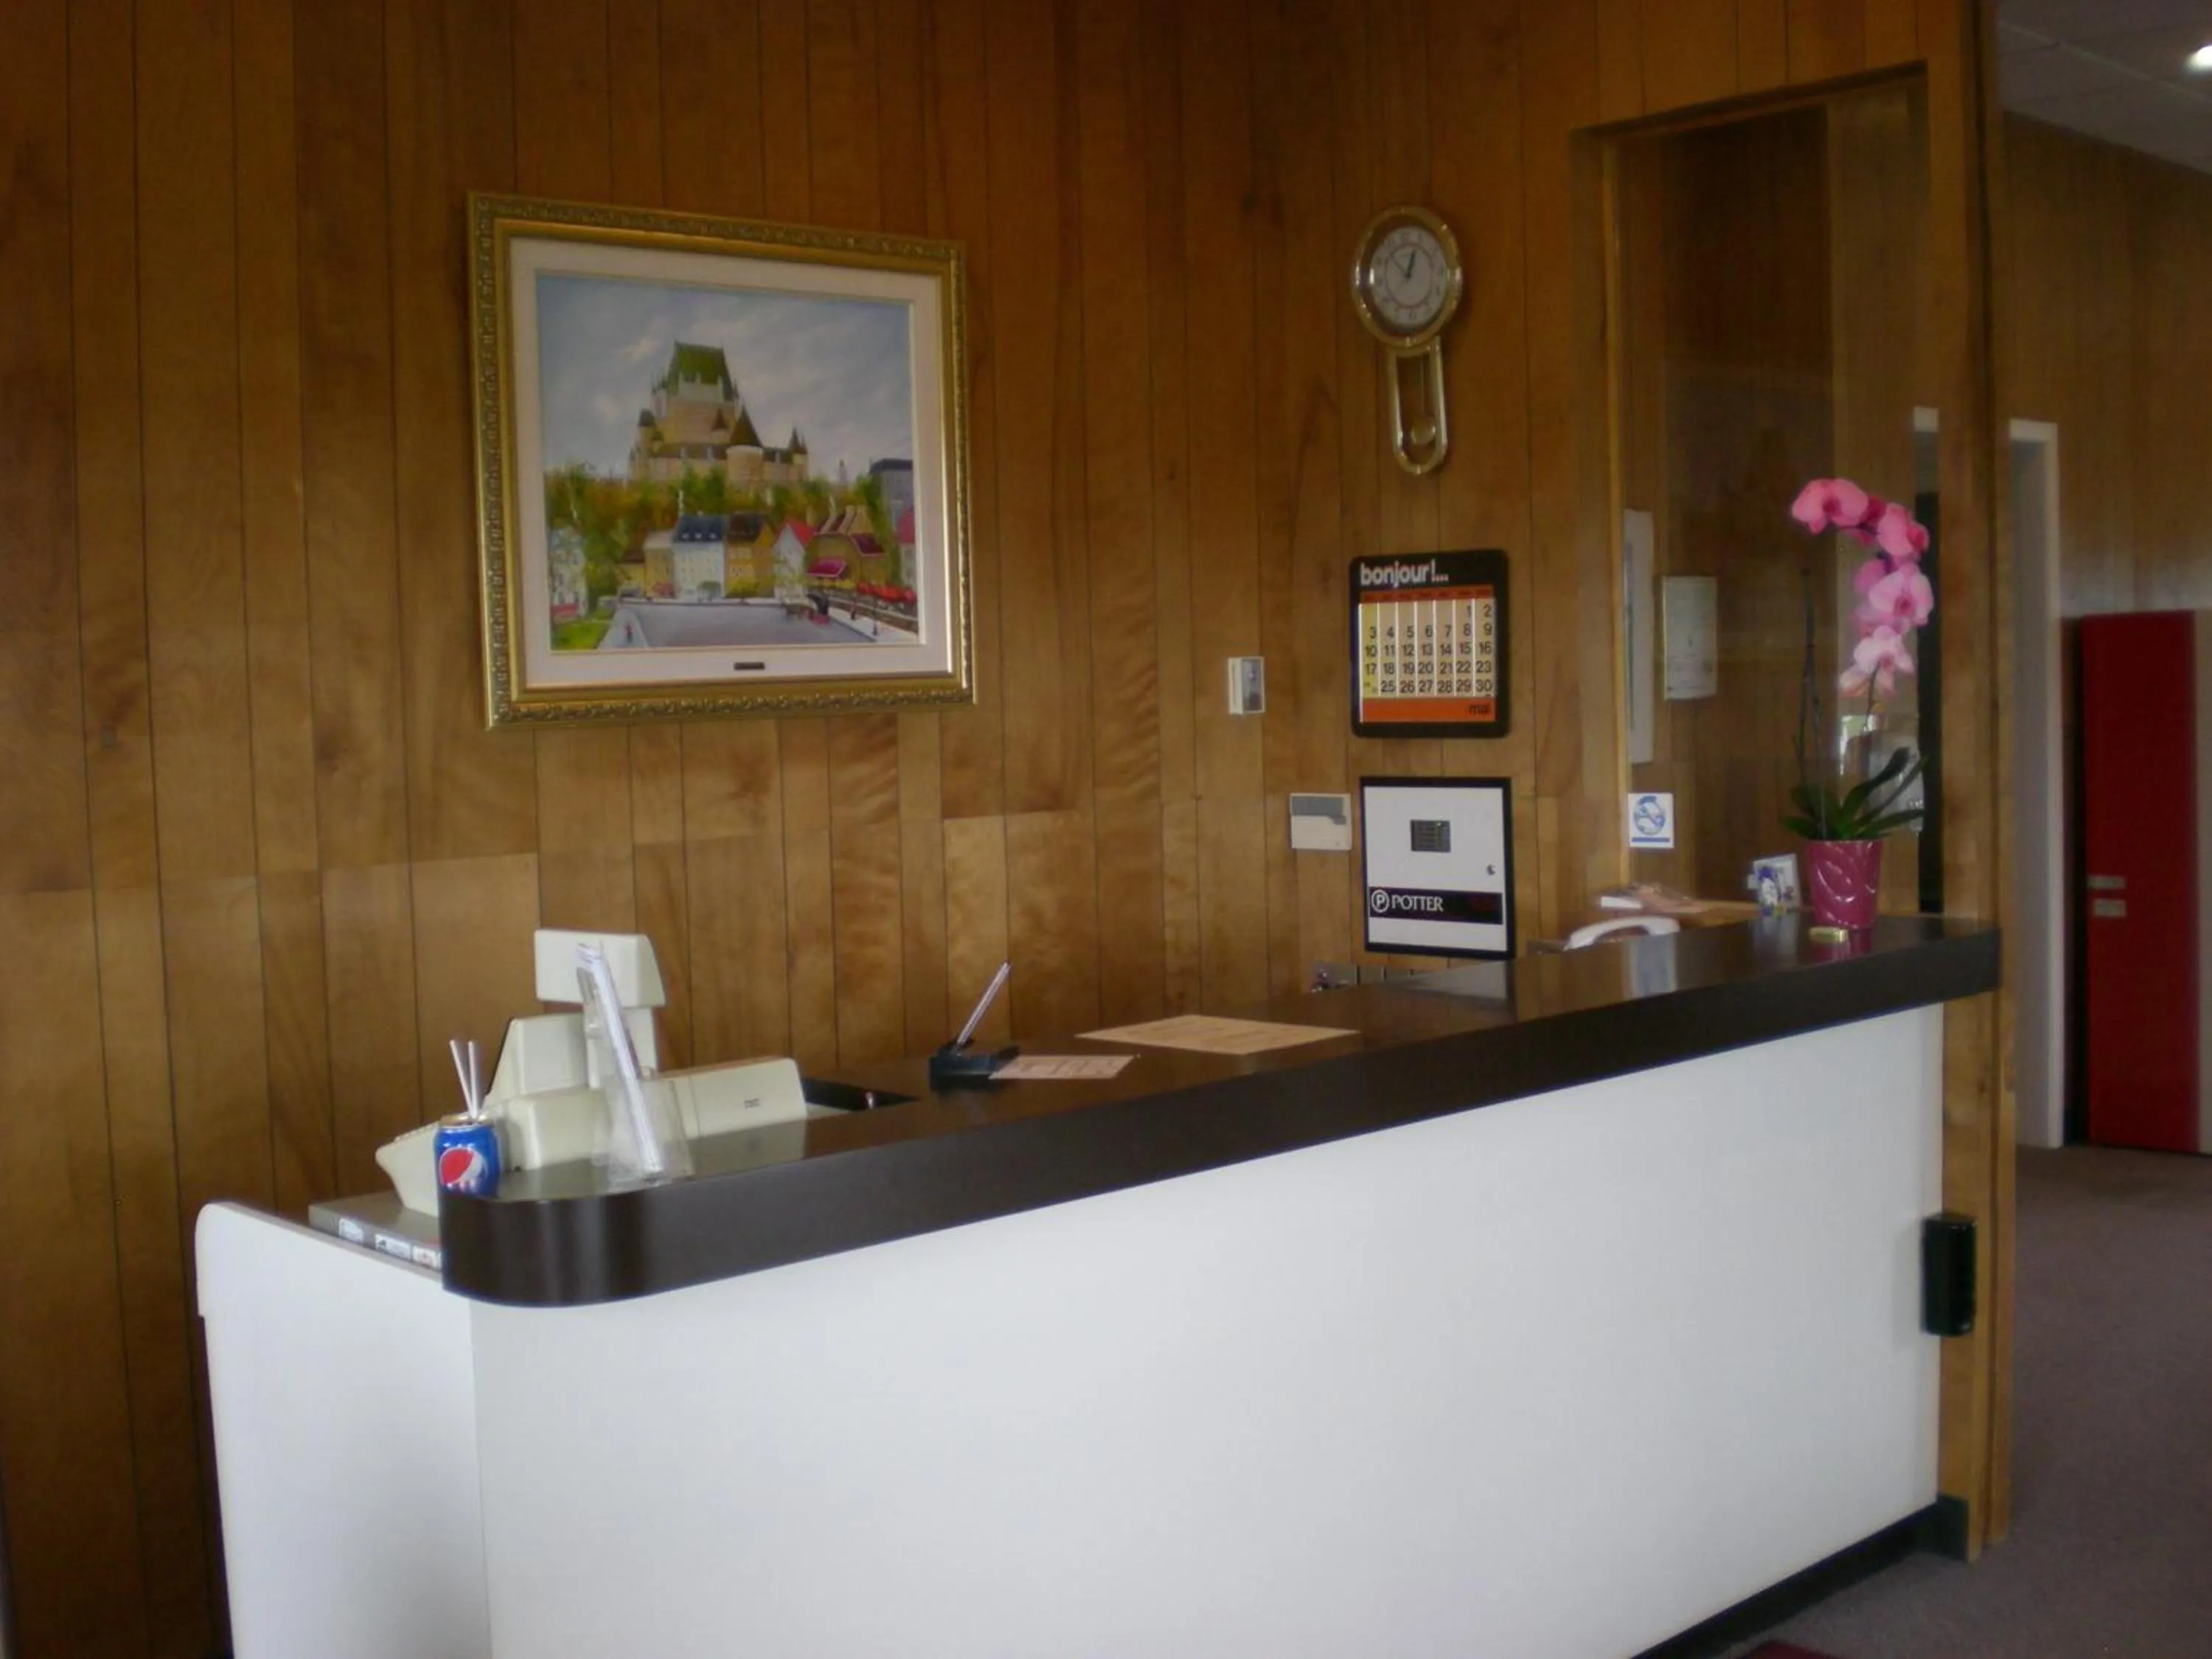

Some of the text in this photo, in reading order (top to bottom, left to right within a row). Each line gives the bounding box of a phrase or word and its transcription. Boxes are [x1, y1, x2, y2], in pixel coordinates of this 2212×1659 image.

[1483, 604, 1492, 617] 2
[1369, 622, 1492, 639] 3 4 5 6 7 8 9
[1365, 641, 1492, 657] 10 11 12 13 14 15 16
[1366, 660, 1492, 676] 17 18 19 20 21 22 23
[1380, 680, 1396, 692] 25
[1400, 680, 1415, 693] 26
[1418, 680, 1433, 693] 27
[1438, 680, 1453, 693] 28
[1456, 679, 1472, 692] 29
[1475, 678, 1492, 692] 30
[1391, 894, 1444, 913] POTTER
